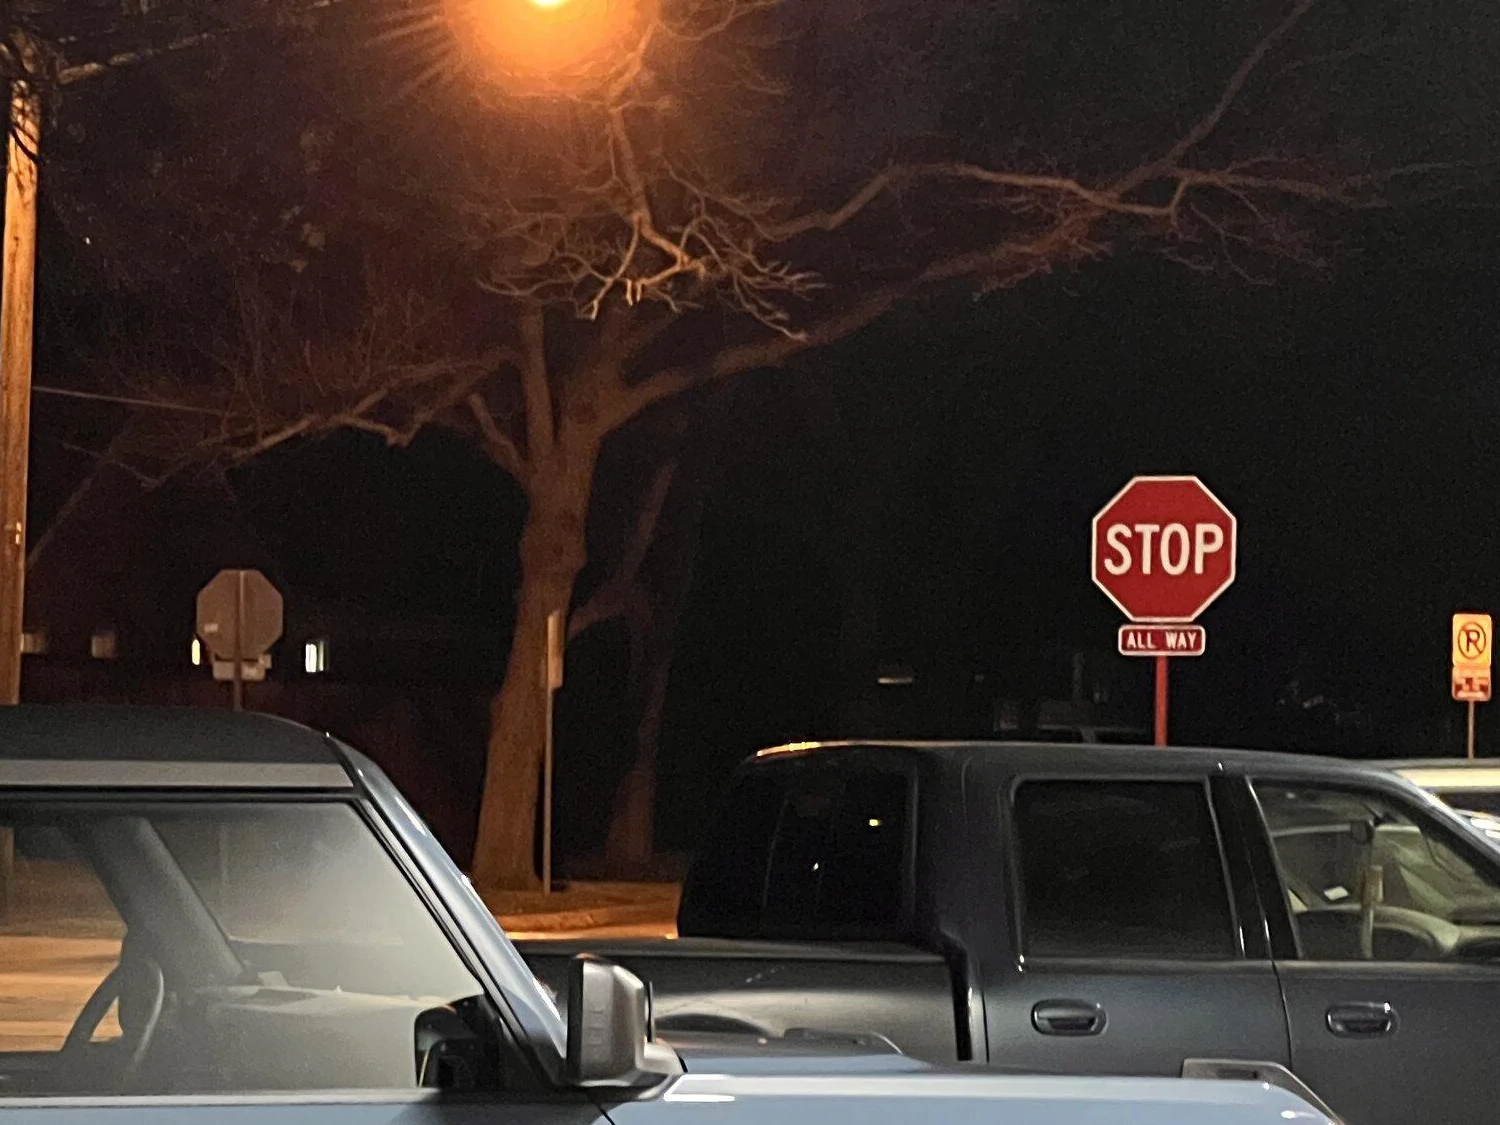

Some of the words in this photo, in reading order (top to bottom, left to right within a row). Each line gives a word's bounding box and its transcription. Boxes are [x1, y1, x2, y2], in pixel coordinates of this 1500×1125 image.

[1104, 523, 1224, 575] STOP
[1126, 632, 1158, 649] ALL
[1165, 632, 1197, 649] WAY
